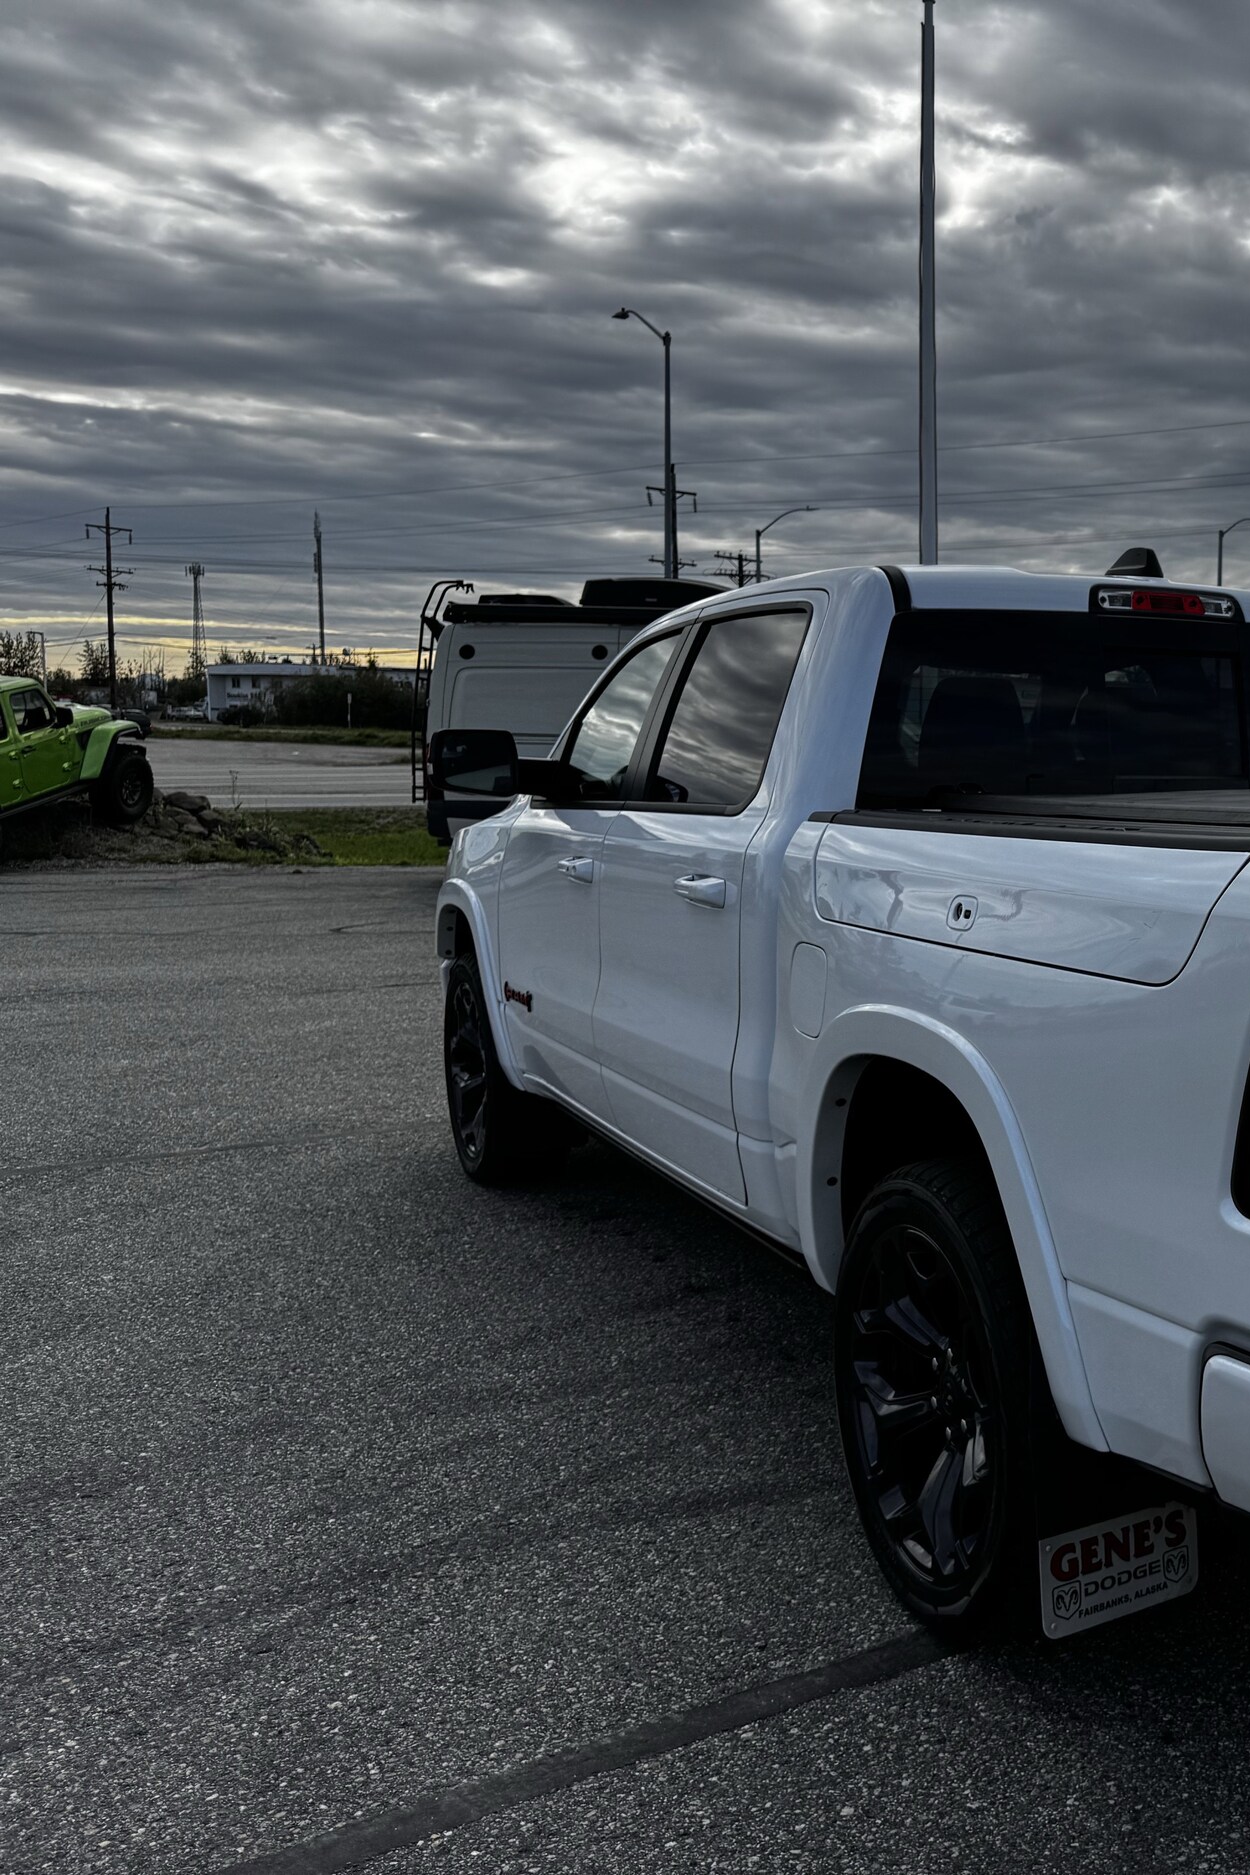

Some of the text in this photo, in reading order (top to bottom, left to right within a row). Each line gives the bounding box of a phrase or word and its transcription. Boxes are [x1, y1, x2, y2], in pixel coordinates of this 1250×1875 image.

[1050, 1509, 1187, 1582] GENE'S
[1084, 1559, 1161, 1598] DODGE
[1078, 1581, 1169, 1618] FAIRBANKS, ALASKA
